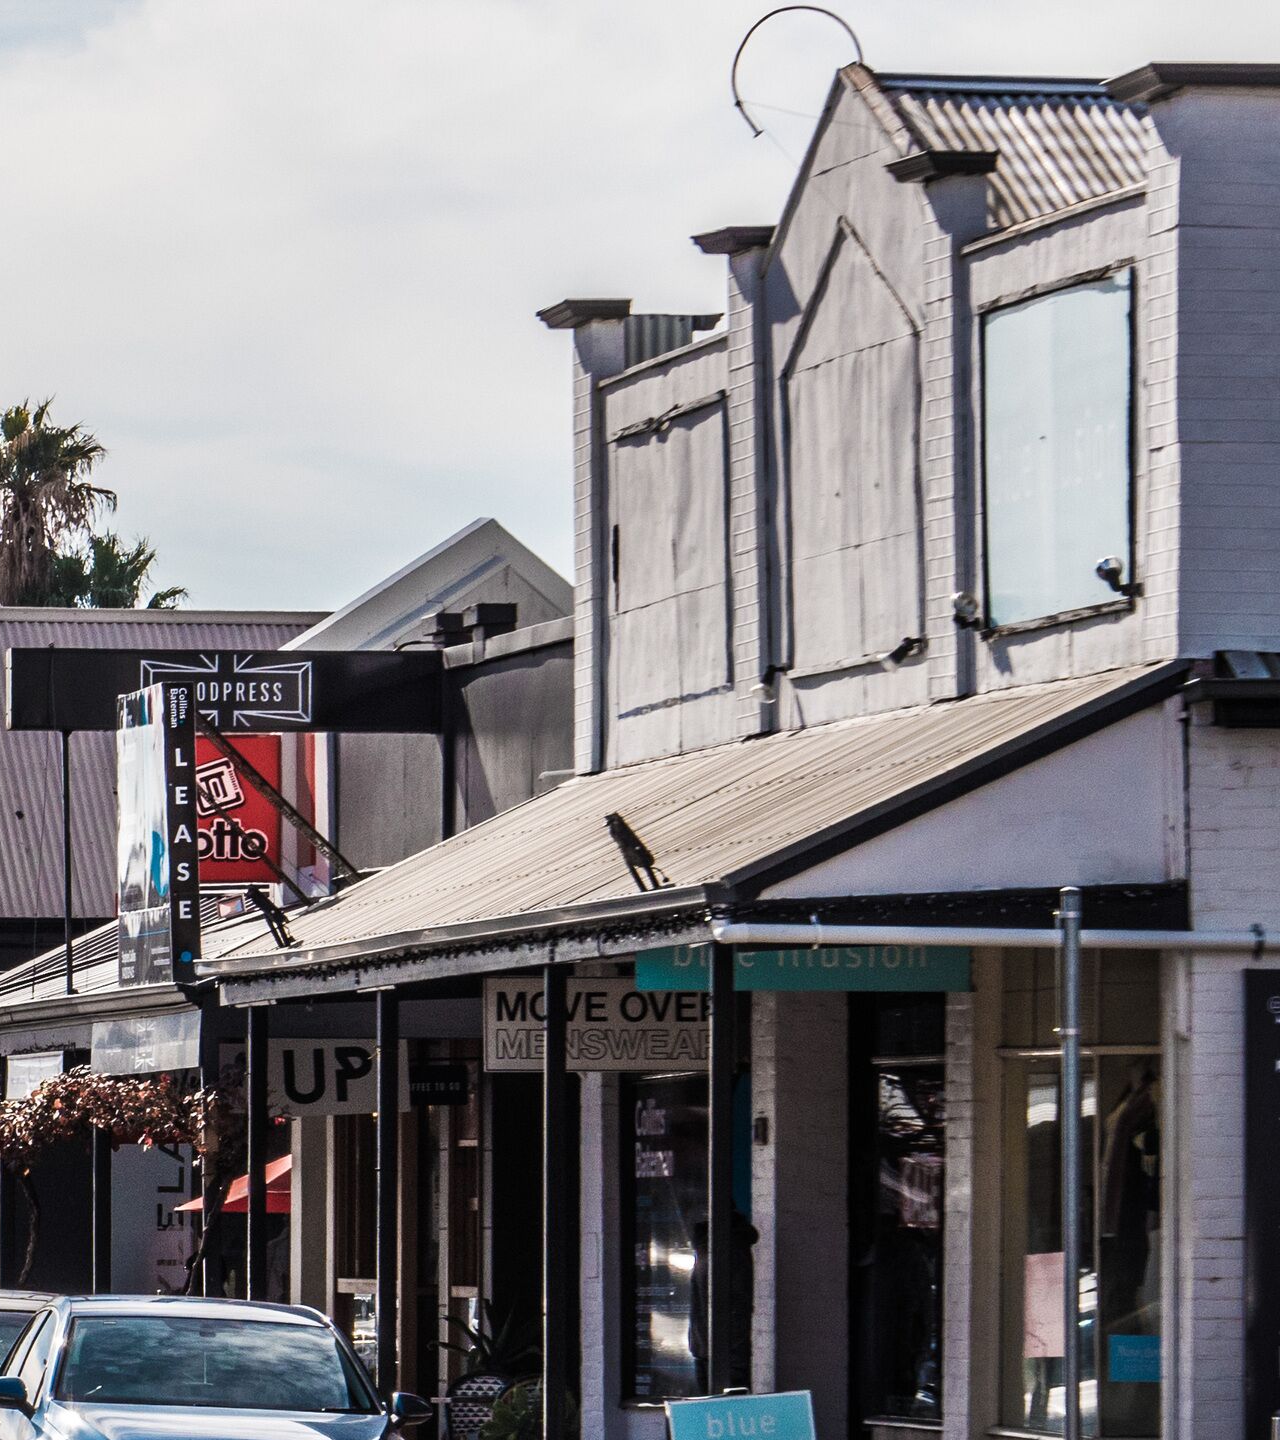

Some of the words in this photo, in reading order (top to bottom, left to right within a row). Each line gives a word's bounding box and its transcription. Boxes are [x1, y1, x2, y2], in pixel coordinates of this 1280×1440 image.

[170, 688, 178, 729] Bateman
[178, 687, 187, 721] Collins
[174, 747, 193, 919] LEASE
[706, 1411, 776, 1439] blue
